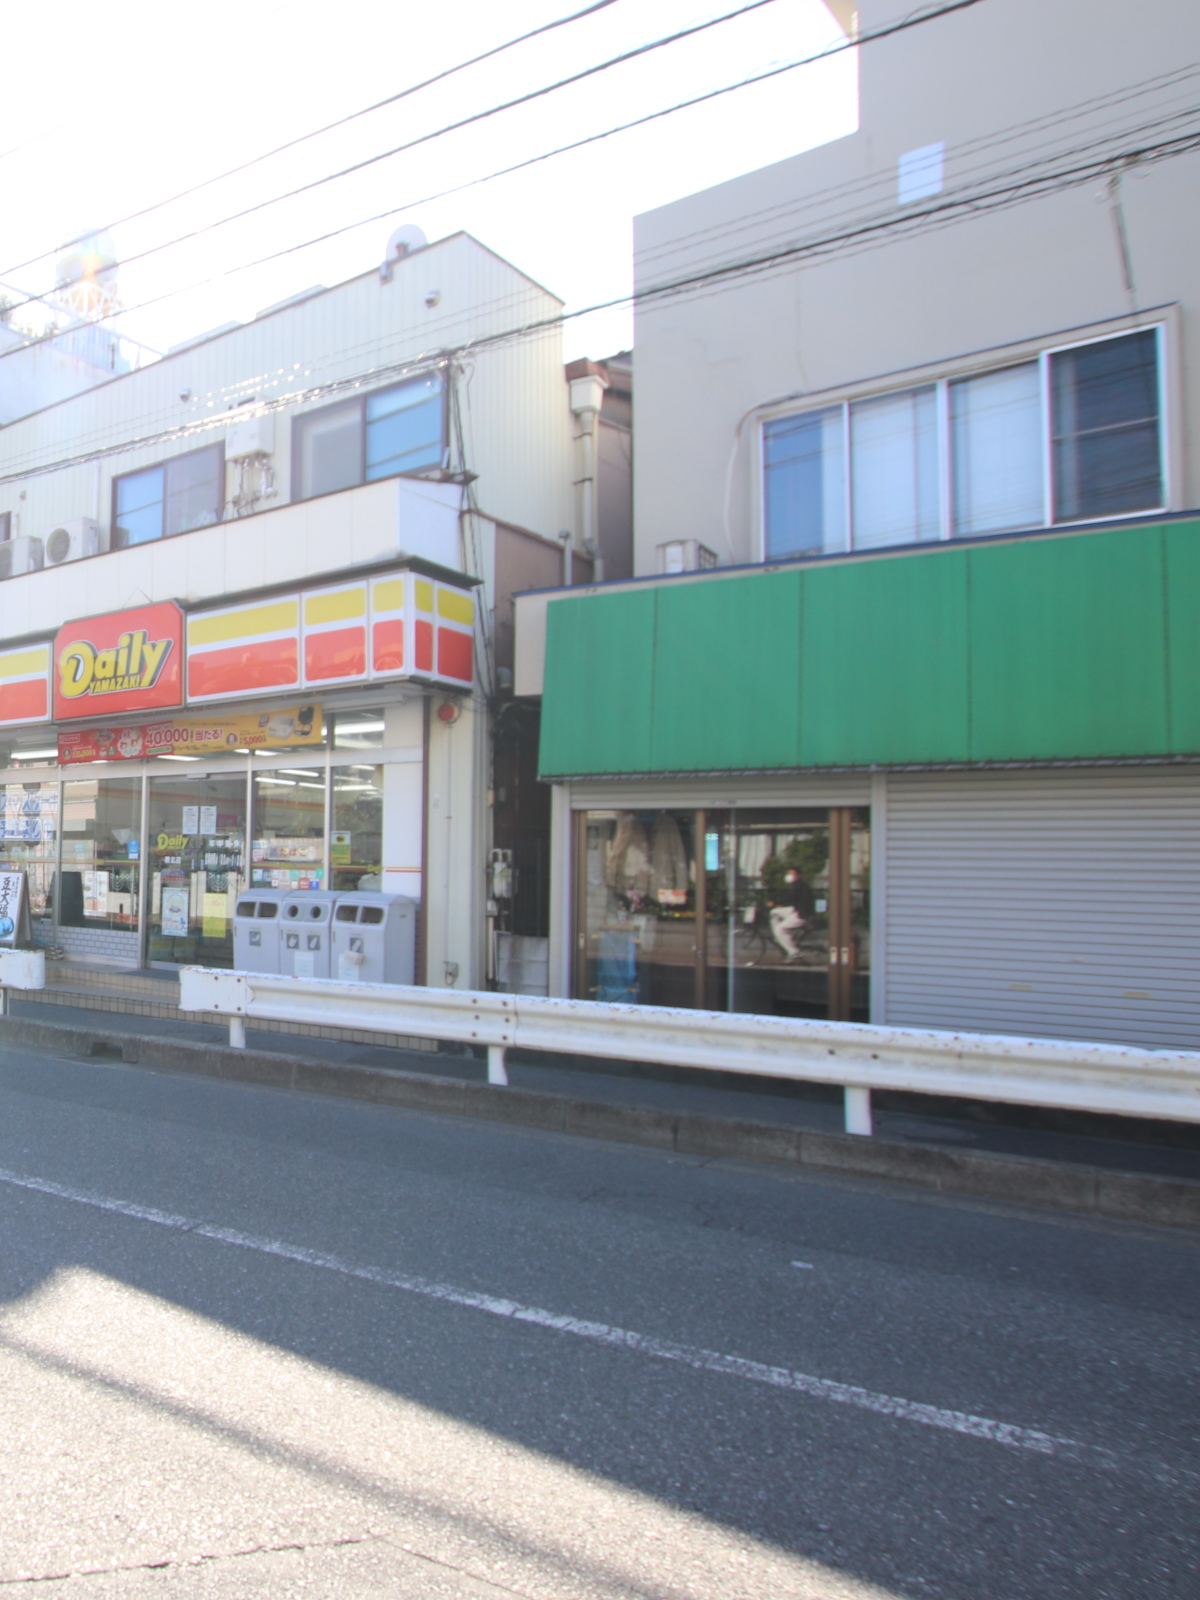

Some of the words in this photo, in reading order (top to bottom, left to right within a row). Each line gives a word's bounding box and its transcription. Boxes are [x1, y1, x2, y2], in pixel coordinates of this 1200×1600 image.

[59, 629, 173, 698] Daily
[89, 674, 140, 694] YAMAZAKI
[157, 833, 189, 849] Daily
